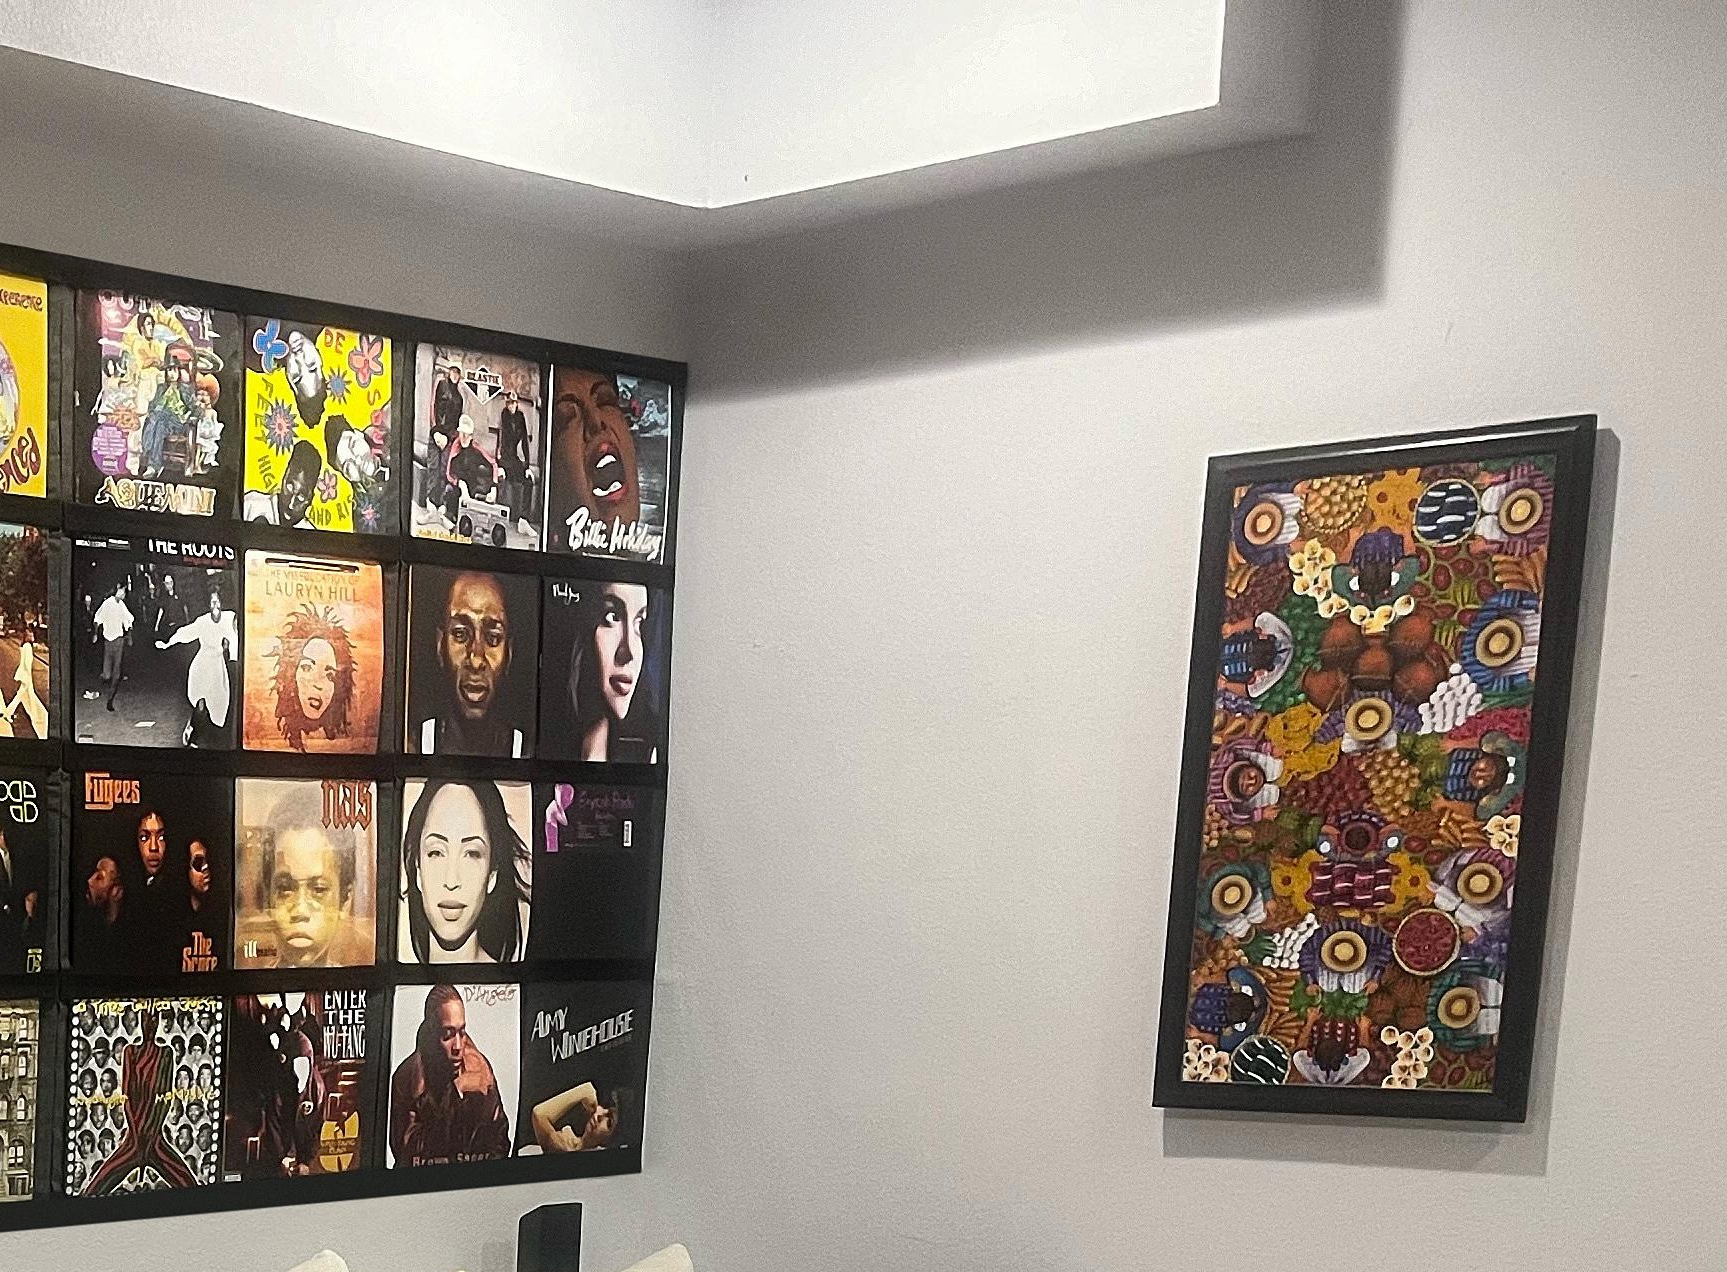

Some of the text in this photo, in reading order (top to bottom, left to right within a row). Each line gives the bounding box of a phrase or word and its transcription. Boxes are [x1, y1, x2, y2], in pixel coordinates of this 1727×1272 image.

[95, 476, 216, 517] AQUEMINI
[565, 505, 662, 561] Billie Holiday
[265, 580, 360, 602] LAURYN HILL
[85, 772, 140, 810] Fugees
[192, 931, 212, 956] The
[324, 1009, 366, 1025] THE
[325, 989, 366, 1009] ENTER
[531, 1006, 569, 1042] AMY
[550, 1009, 635, 1064] WINEHOUSE
